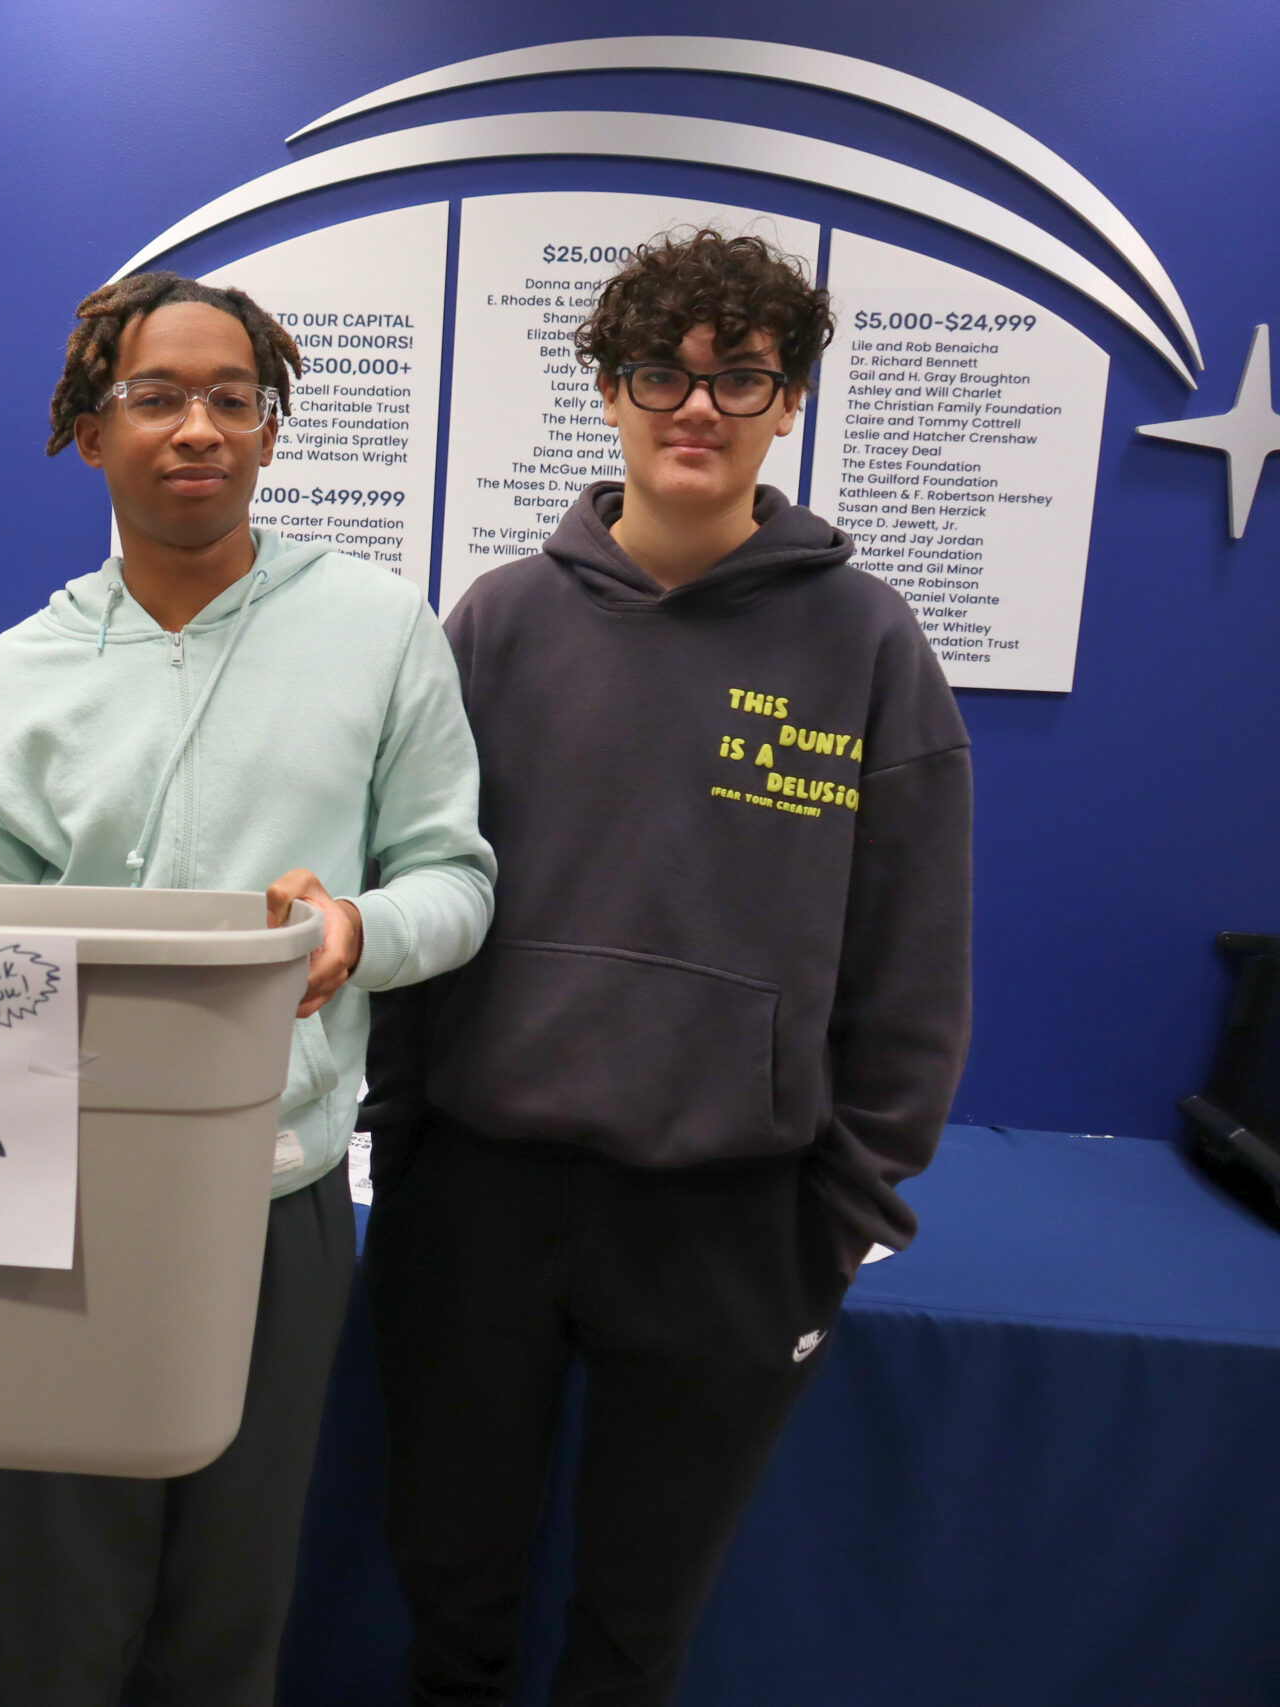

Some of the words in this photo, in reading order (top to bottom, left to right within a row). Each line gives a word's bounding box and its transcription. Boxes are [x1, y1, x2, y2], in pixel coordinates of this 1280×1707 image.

[543, 244, 631, 264] $25,000
[526, 278, 570, 290] Donna
[574, 279, 601, 290] and
[488, 295, 497, 305] E.
[501, 295, 551, 306] Rhodes
[555, 296, 565, 307] &
[277, 313, 298, 326] TO
[303, 313, 338, 327] OUR
[343, 314, 414, 328] CAPITAL
[294, 334, 333, 348] AIGN
[338, 335, 413, 349] DONORS!
[527, 329, 574, 341] Elizabe
[540, 346, 570, 357] Beth
[852, 340, 873, 351] Lile
[876, 341, 902, 351] and
[906, 342, 932, 352] Rob
[935, 342, 998, 353] Benaicha
[301, 356, 412, 376] $500,000+
[851, 355, 867, 365] Dr.
[872, 355, 922, 367] Richard
[926, 357, 978, 368] Bennett
[543, 363, 577, 378] Judy
[551, 380, 589, 391] Laura
[849, 370, 875, 380] Gail
[878, 371, 905, 381] and
[908, 371, 920, 382] H.
[924, 372, 957, 386] Gray
[960, 373, 1030, 388] Broughton
[333, 385, 411, 397] Foundation
[848, 385, 892, 399] Ashley
[895, 386, 921, 397] and
[925, 387, 949, 397] Will
[952, 387, 1002, 398] Charlet
[300, 401, 372, 413] Charitable
[376, 402, 410, 414] Trust
[555, 397, 586, 412] Kelly
[848, 400, 871, 410] The
[874, 400, 934, 412] Christian
[938, 402, 982, 416] Family
[985, 403, 1062, 415] Foundation
[288, 416, 328, 428] Gates
[332, 418, 409, 430] Foundation
[542, 413, 566, 424] The
[570, 414, 606, 425] Hern
[846, 414, 884, 425] Claire
[888, 416, 914, 426] and
[918, 416, 968, 430] Tommy
[972, 418, 1021, 429] Cottrell
[278, 433, 292, 443] rs.
[297, 433, 348, 448] Virginia
[352, 434, 408, 450] Spratley
[548, 430, 572, 441] The
[845, 429, 880, 440] Leslie
[883, 430, 910, 440] and
[913, 431, 966, 442] Hatcher
[969, 433, 1037, 444] Crenshaw
[276, 449, 303, 460] and
[307, 450, 358, 461] Watson
[363, 451, 407, 466] Wright
[533, 446, 573, 458] Diana
[577, 448, 604, 459] and
[843, 444, 860, 454] Dr.
[864, 444, 908, 459] Tracey
[912, 446, 942, 456] Deal
[512, 462, 536, 473] The
[540, 463, 587, 475] McGue
[591, 465, 625, 476] Millhi
[842, 458, 866, 469] The
[869, 459, 902, 470] Estes
[906, 460, 981, 472] Foundation
[477, 478, 500, 489] The
[503, 478, 545, 490] Moses
[549, 480, 560, 491] D.
[841, 473, 864, 483] The
[868, 473, 919, 485] Guilford
[923, 475, 998, 487] Foundation
[255, 487, 405, 507] ,000-$499,999
[514, 496, 569, 508] Barbara
[840, 488, 897, 499] Kathleen
[900, 489, 910, 499] &
[914, 490, 923, 500] F.
[927, 490, 994, 502] Robertson
[998, 493, 1053, 507] Hershey
[838, 502, 878, 513] Susan
[881, 504, 907, 514] and
[911, 504, 935, 515] Ben
[939, 505, 986, 517] Herzick
[251, 513, 277, 525] irne
[281, 515, 324, 526] Carter
[327, 516, 404, 529] Foundation
[536, 513, 559, 524] Teri
[837, 516, 873, 530] Bryce
[877, 518, 888, 528] D.
[892, 519, 938, 532] Jewett,
[942, 520, 957, 530] Jr.
[335, 533, 403, 549] Company
[472, 527, 496, 538] The
[500, 528, 551, 543] Virginia
[850, 533, 877, 545] ncy
[880, 533, 906, 543] and
[910, 534, 933, 547] Jay
[937, 535, 983, 546] Jordan
[374, 551, 402, 561] Trust
[468, 543, 490, 554] The
[493, 544, 538, 556] William
[861, 546, 904, 557] Markel
[908, 548, 982, 560] Foundation
[846, 561, 894, 572] arlotte
[897, 563, 923, 573] and
[926, 563, 943, 573] Gil
[947, 564, 984, 575] Minor
[918, 578, 979, 589] Robinson
[905, 592, 945, 602] Daniel
[949, 593, 999, 605] Volante
[923, 607, 968, 618] Walker
[943, 622, 991, 636] Whitley
[930, 637, 983, 647] ndation
[987, 639, 1019, 649] Trust
[942, 651, 990, 662] Winters
[754, 743, 774, 768] A
[766, 772, 859, 811] DELUSiO
[745, 793, 773, 808] YOUR
